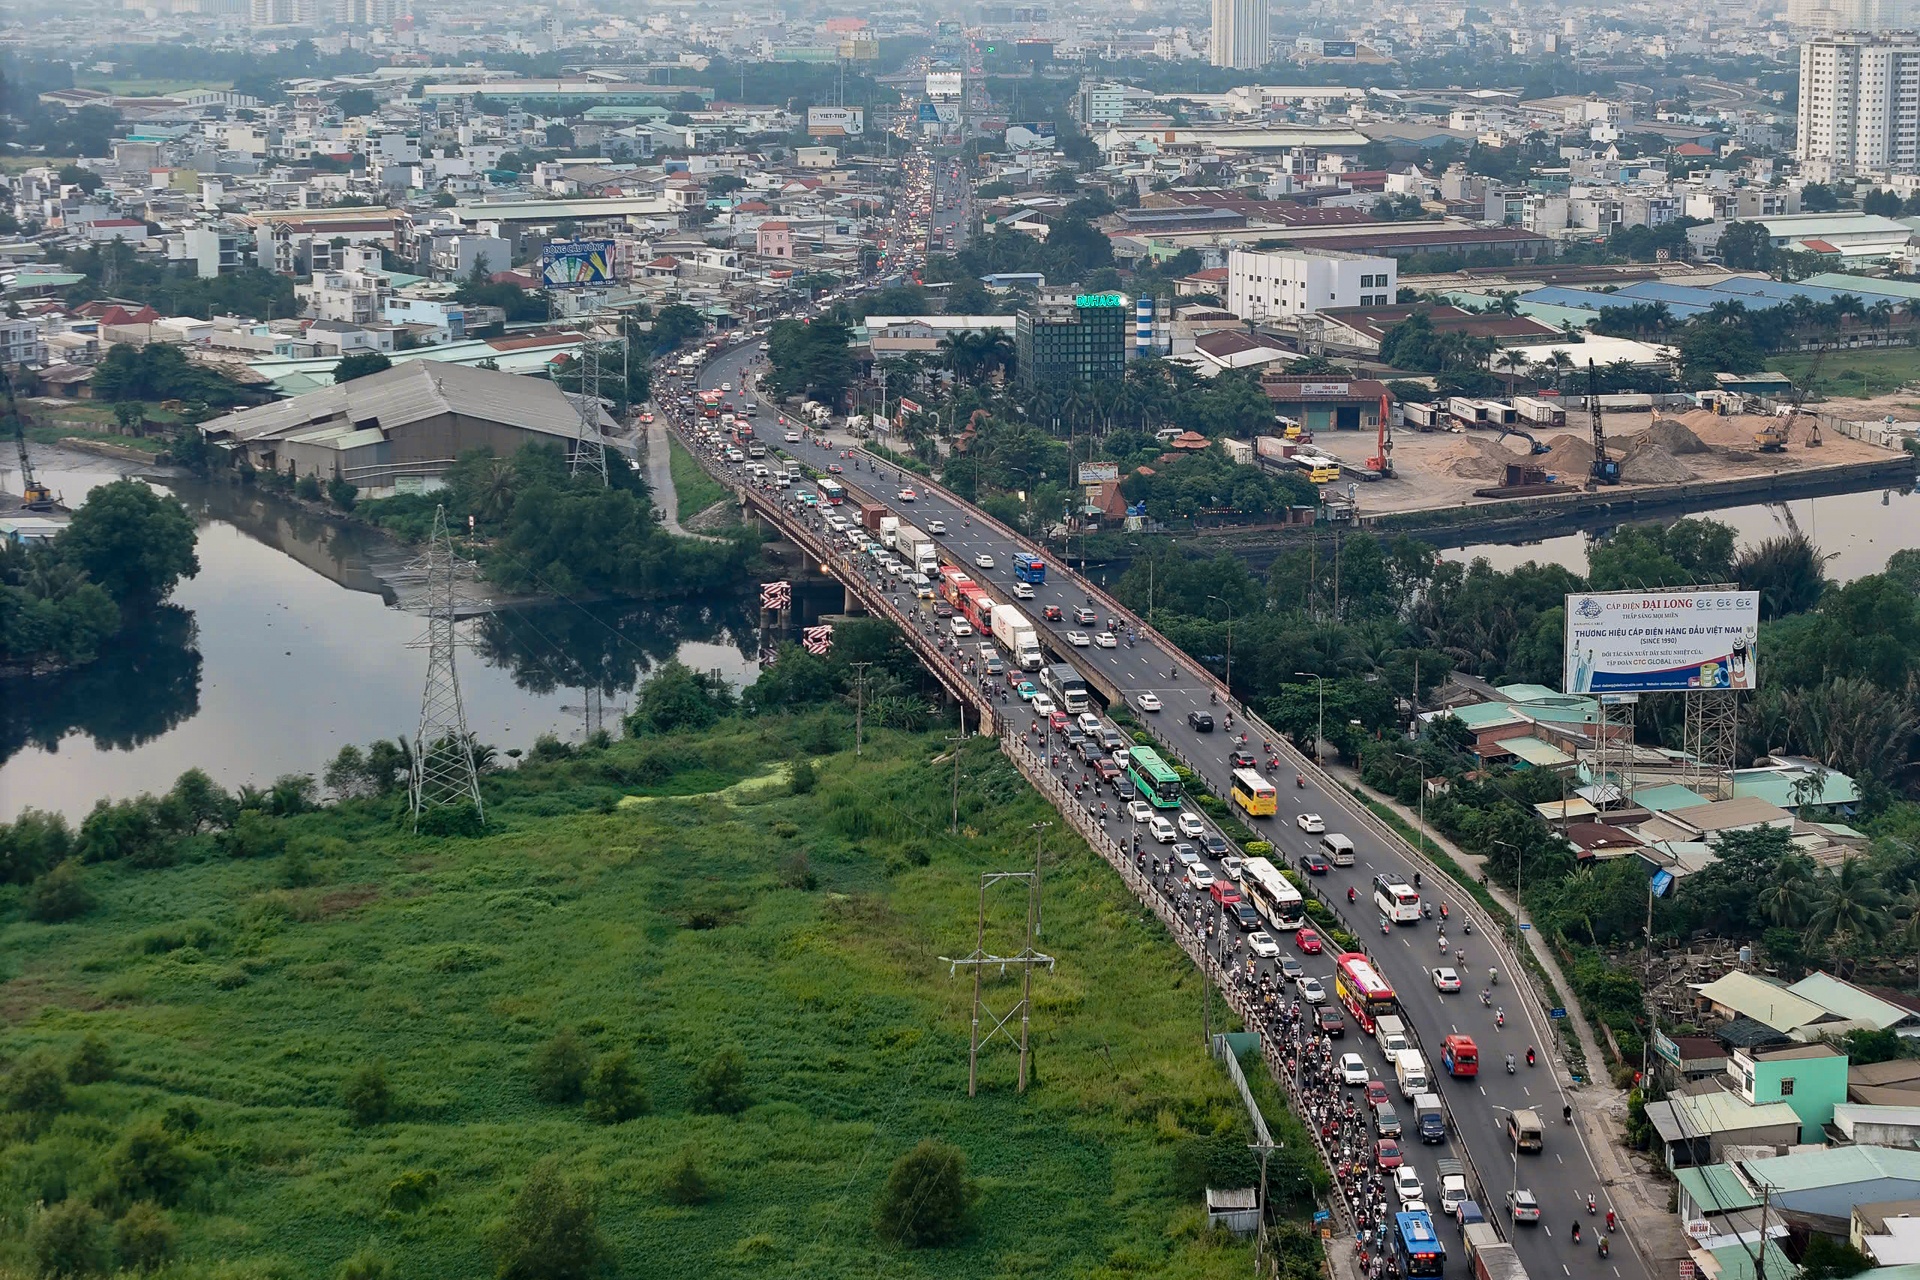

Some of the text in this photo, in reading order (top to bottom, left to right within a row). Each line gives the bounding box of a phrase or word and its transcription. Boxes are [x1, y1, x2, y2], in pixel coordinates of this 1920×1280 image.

[1076, 294, 1120, 307] DUHACO
[1606, 599, 1693, 611] CÁP ĐIỆN ĐẠI LONG
[1575, 628, 1606, 637] THƯƠNG
[1608, 628, 1626, 638] HIỆU
[1645, 627, 1663, 637] ĐIỆN
[1665, 626, 1686, 635] HÀNG
[1689, 625, 1704, 634] ĐẦU
[1706, 625, 1722, 635] VIỆT
